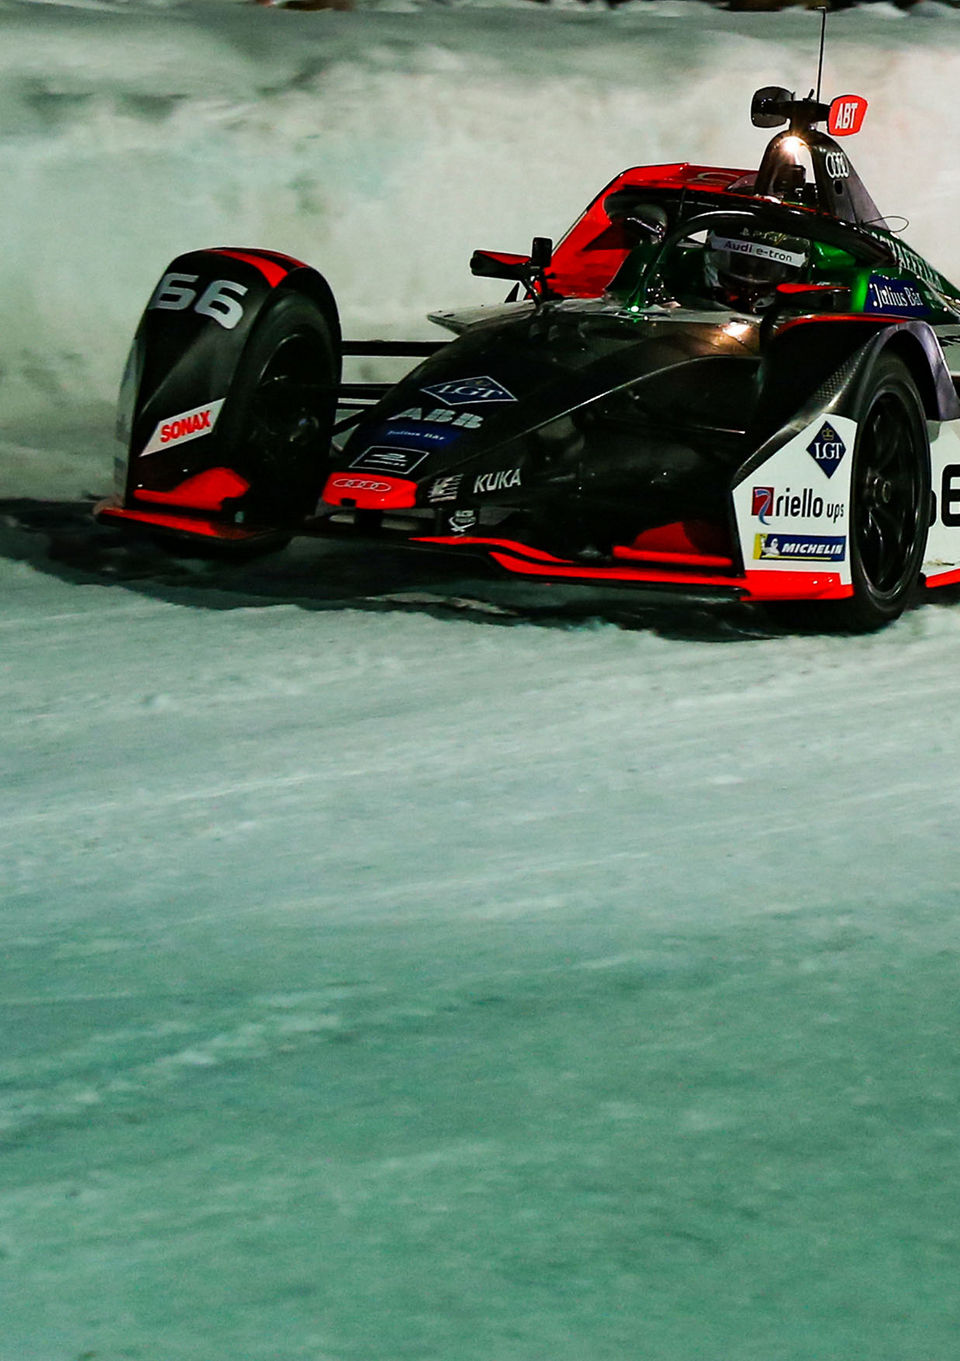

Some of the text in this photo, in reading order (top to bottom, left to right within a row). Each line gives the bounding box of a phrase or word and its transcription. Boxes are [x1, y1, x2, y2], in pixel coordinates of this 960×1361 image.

[835, 103, 858, 129] ABT
[723, 239, 793, 263] Audi e-tron
[147, 272, 249, 330] 66
[160, 410, 211, 443] SONAX
[386, 407, 484, 429] ABB
[814, 442, 843, 460] LGT
[473, 468, 522, 494] KUKA
[775, 487, 845, 524] riello ups
[781, 543, 844, 554] MICHELIN
